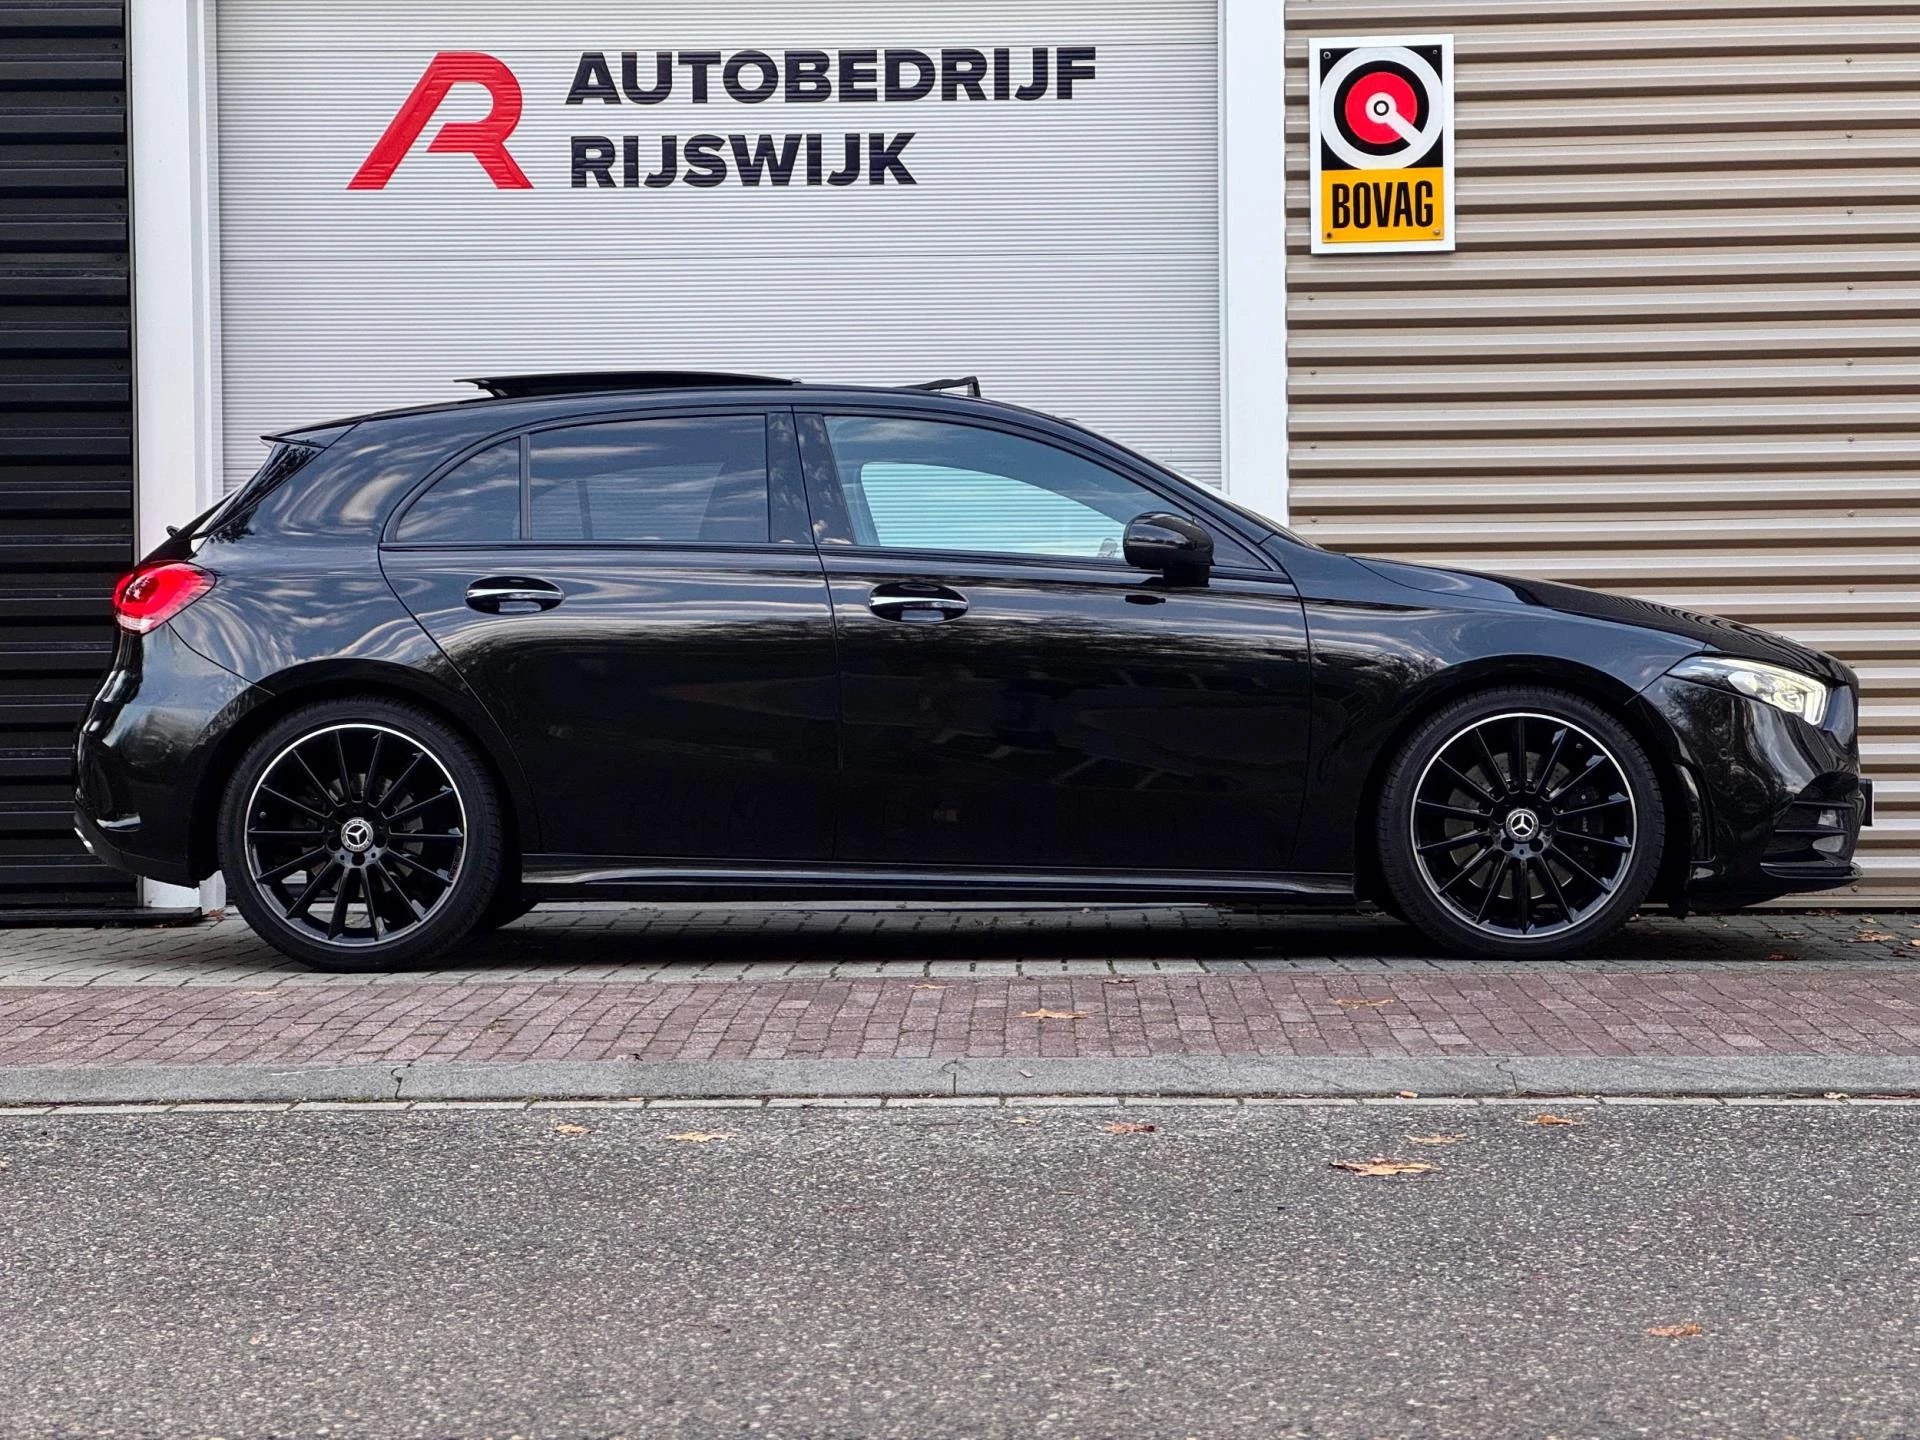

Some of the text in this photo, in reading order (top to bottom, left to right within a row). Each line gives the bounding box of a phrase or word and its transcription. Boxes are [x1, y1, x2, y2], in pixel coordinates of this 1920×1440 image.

[565, 46, 1097, 104] AUTOBEDRIJF
[570, 131, 917, 189] RIJSWIJK
[1332, 180, 1433, 229] BOVAG
